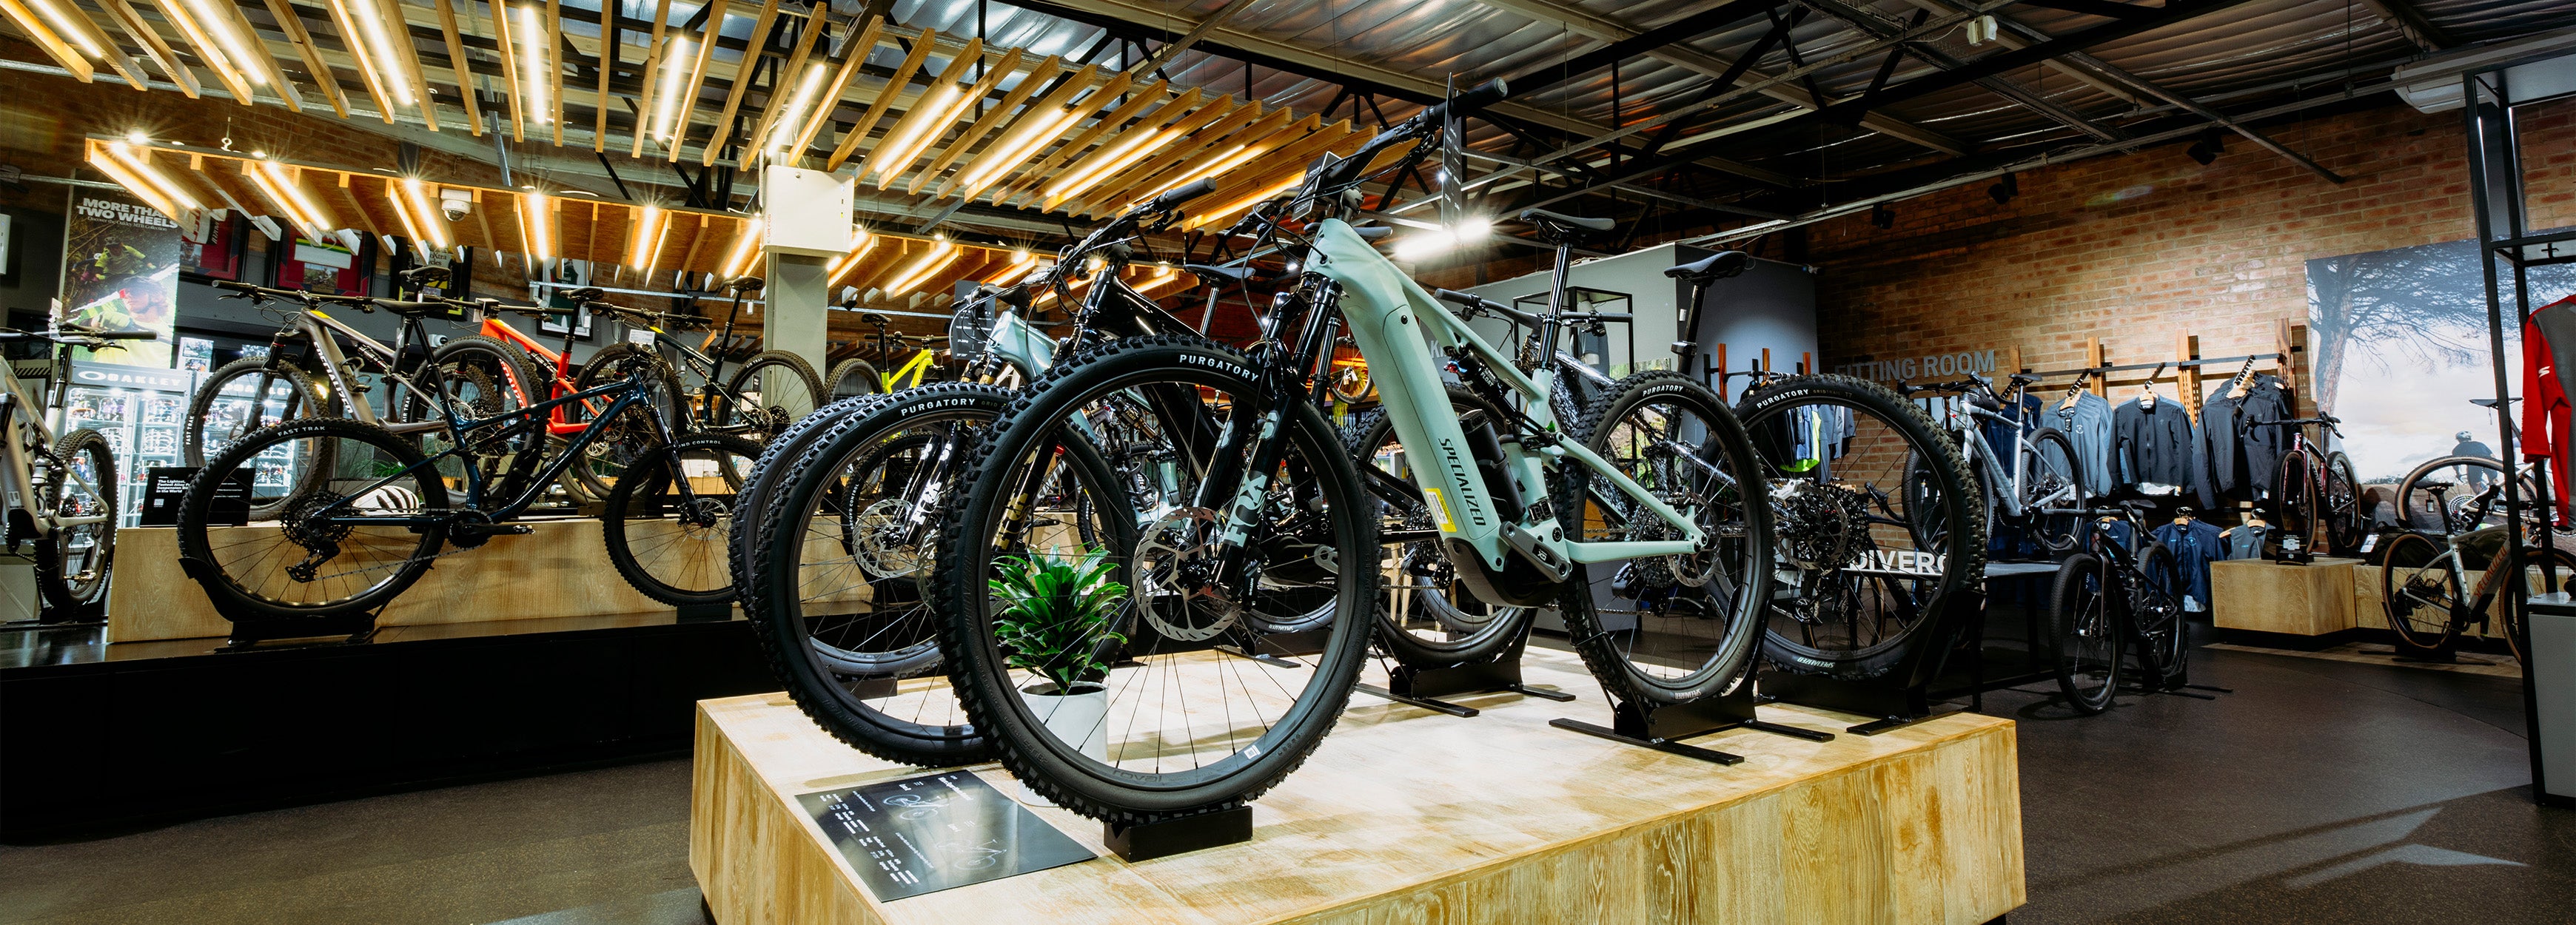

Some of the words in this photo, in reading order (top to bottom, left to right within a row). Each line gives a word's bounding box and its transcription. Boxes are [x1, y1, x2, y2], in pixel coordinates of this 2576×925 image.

[77, 206, 115, 219] TWO
[118, 212, 178, 229] WHEELS
[83, 198, 130, 212] MORE
[133, 205, 164, 219] THA
[144, 223, 167, 232] Collection
[1179, 354, 1259, 382] PURGATORY
[1834, 357, 1916, 382] FITTING
[1923, 349, 1996, 378] ROOM
[107, 371, 182, 386] OAKLEY
[1480, 371, 1494, 387] FLOAT
[1643, 385, 1683, 397] PURGATORY
[1757, 389, 1809, 408] PURGATORY
[901, 398, 976, 416] PURGATORY
[277, 428, 299, 437] FAST
[1438, 437, 1486, 526] SPECIALIZED
[850, 484, 859, 507] CONTROL
[911, 480, 943, 525] FOX
[1222, 471, 1270, 548] FOX
[992, 492, 1030, 550] FOX
[1849, 549, 1948, 575] DIVER
[2473, 545, 2508, 598] SPECIALIZED
[1797, 656, 1836, 668] SPECIALIZED
[1112, 769, 1162, 783] roval
